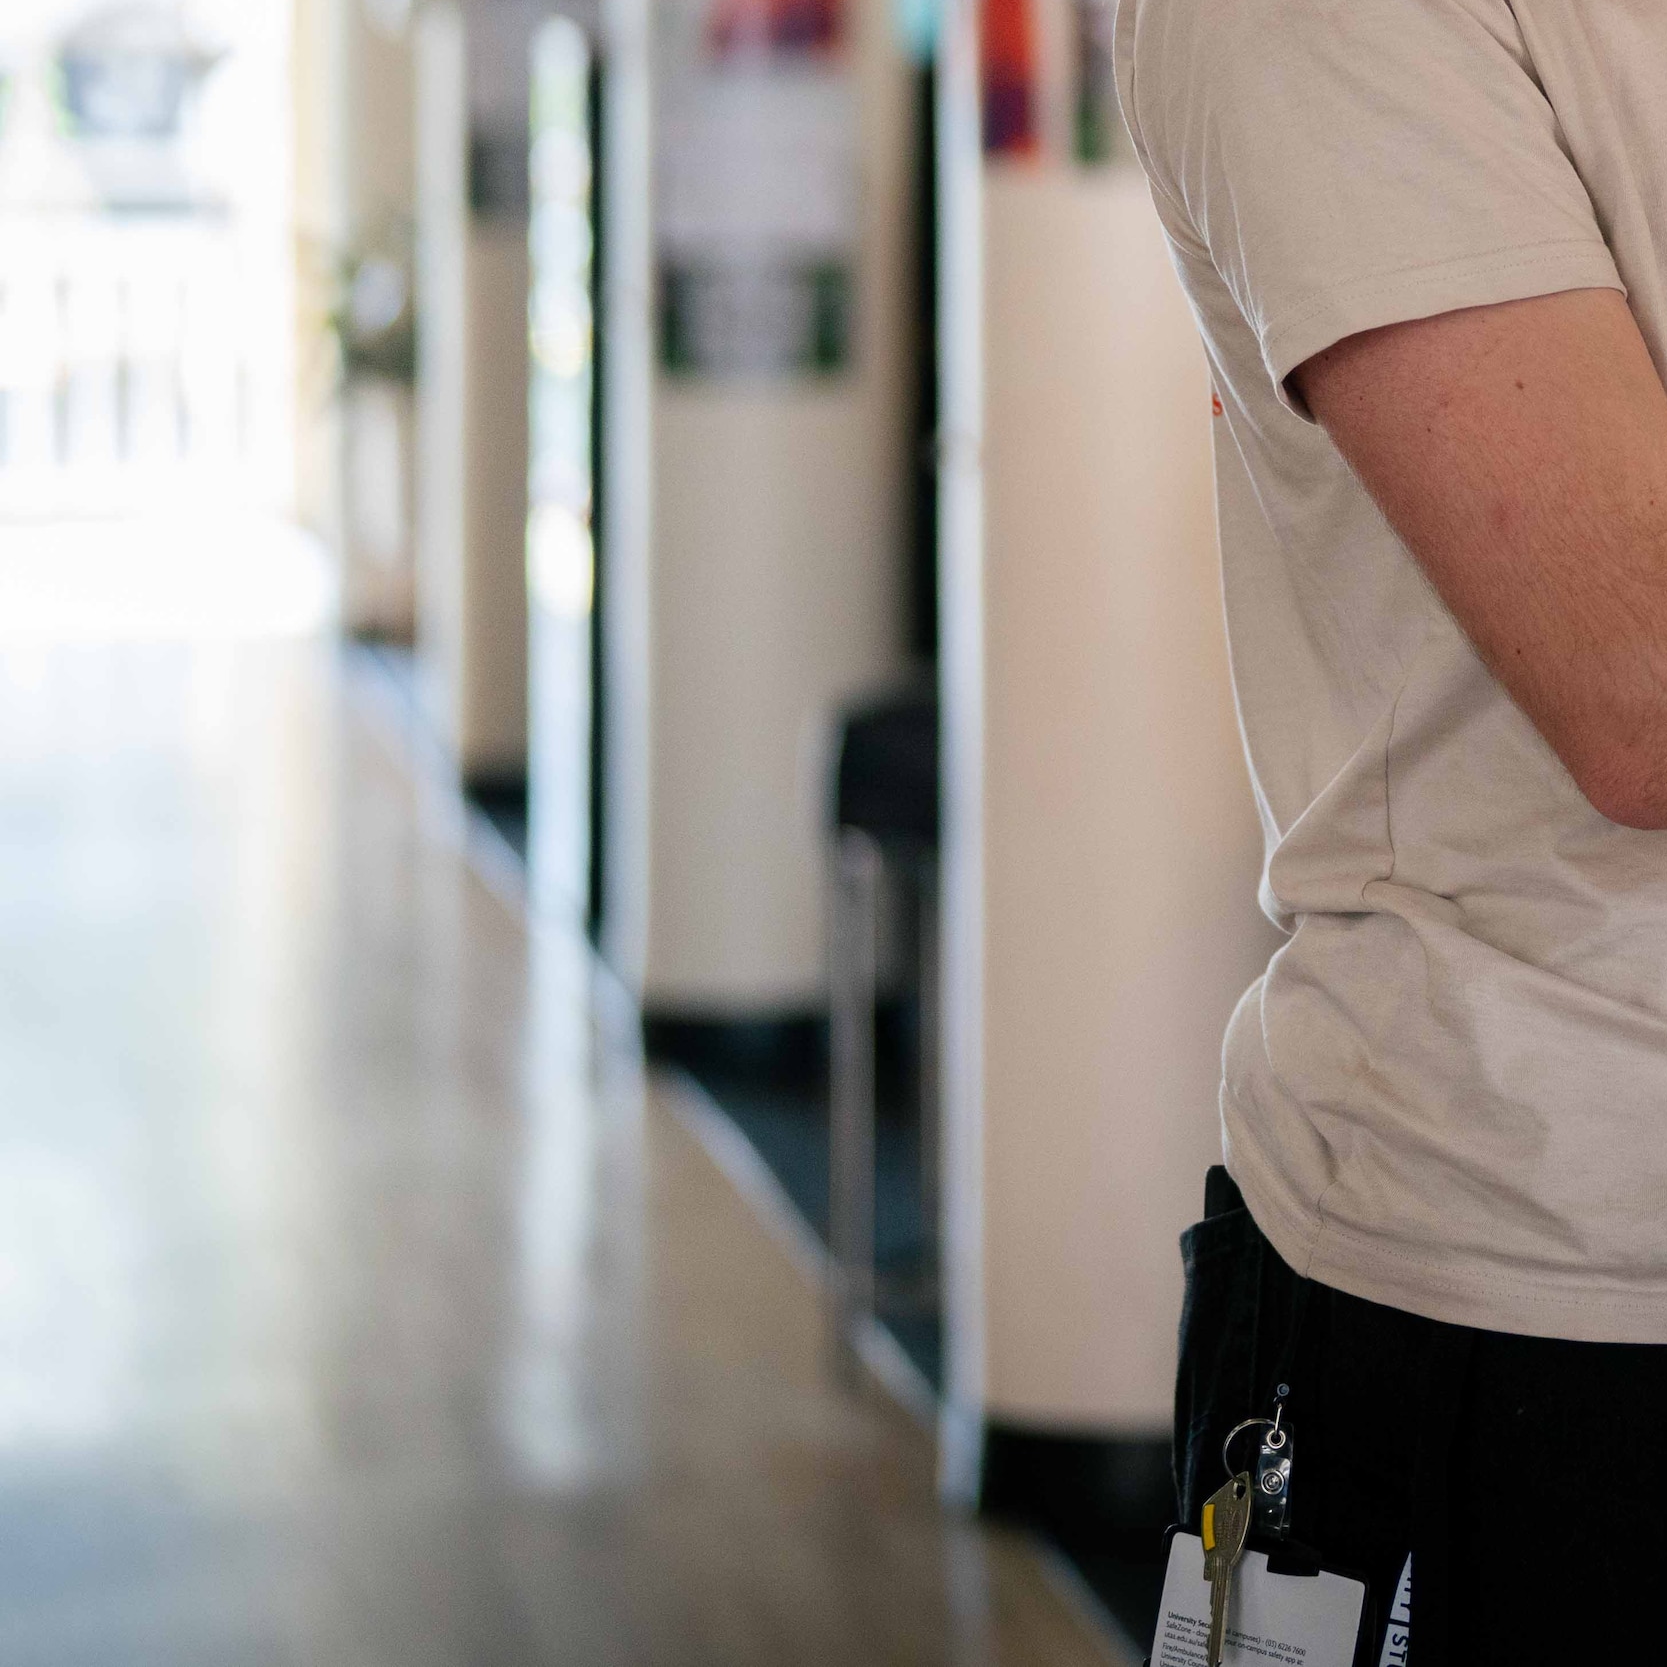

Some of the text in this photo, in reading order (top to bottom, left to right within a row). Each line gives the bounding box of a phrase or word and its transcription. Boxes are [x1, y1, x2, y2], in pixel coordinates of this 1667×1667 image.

[1168, 1610, 1197, 1626] University
[1161, 1651, 1186, 1666] University
[1268, 1651, 1284, 1662] safety
[1285, 1656, 1296, 1664] app
